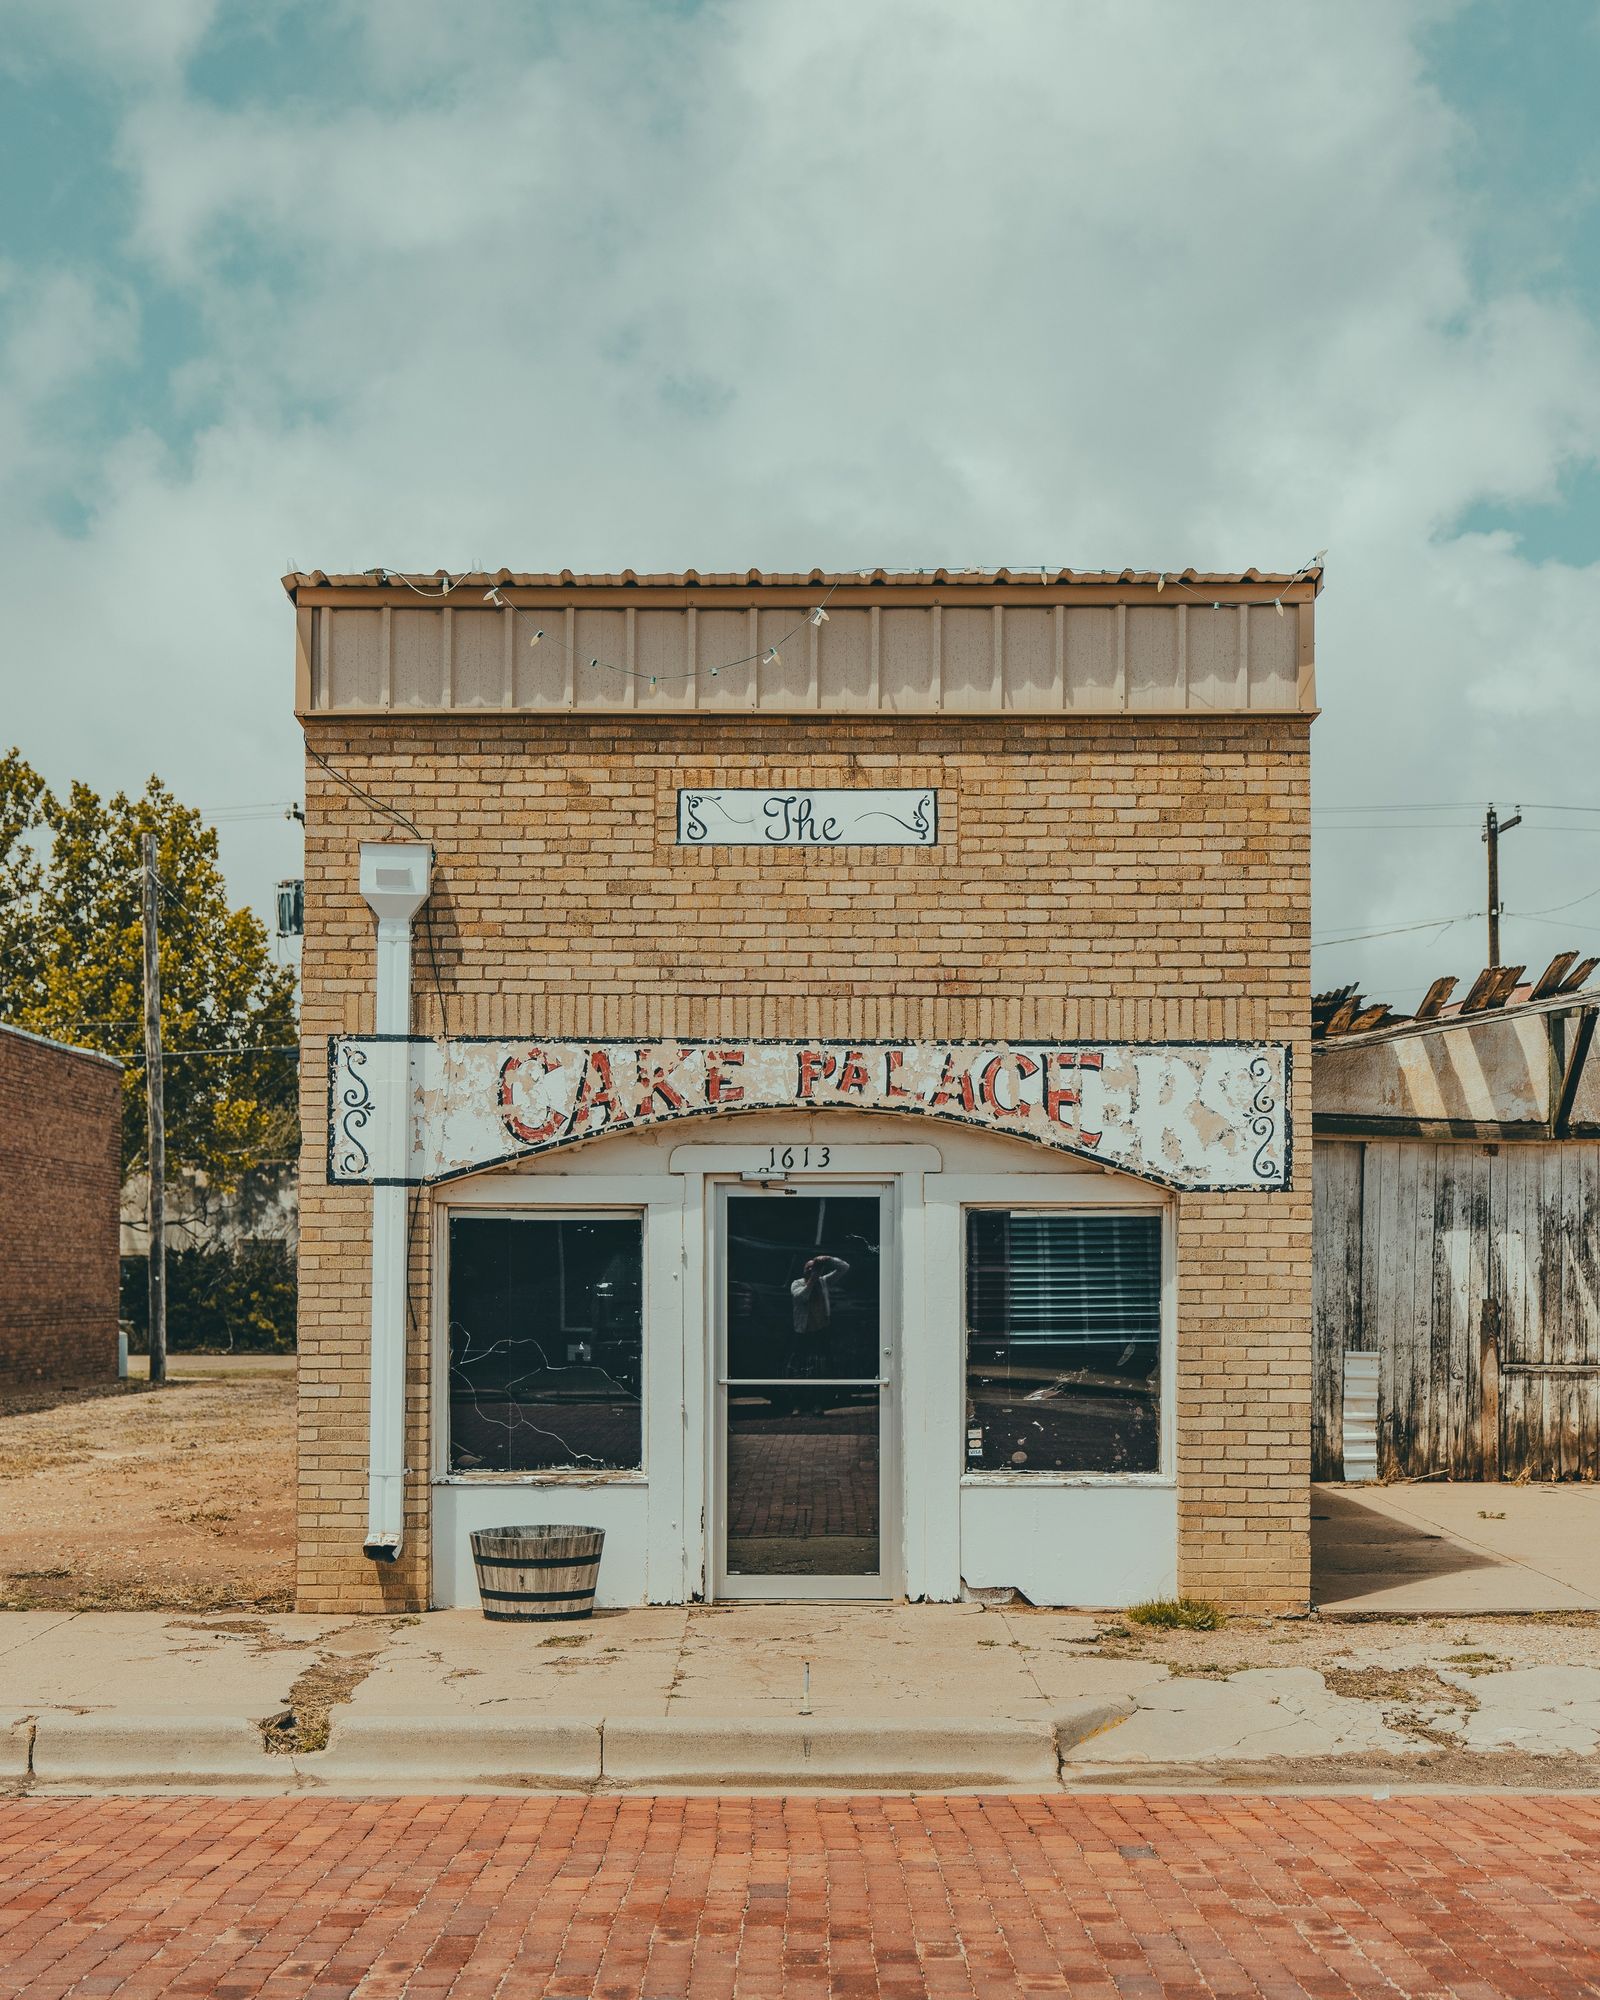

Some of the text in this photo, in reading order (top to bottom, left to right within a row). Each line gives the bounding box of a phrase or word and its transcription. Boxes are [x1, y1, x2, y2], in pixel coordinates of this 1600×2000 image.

[763, 796, 843, 841] The
[497, 1047, 745, 1145] CAKE
[796, 1050, 1104, 1148] PALACE
[769, 1146, 831, 1169] 1613
